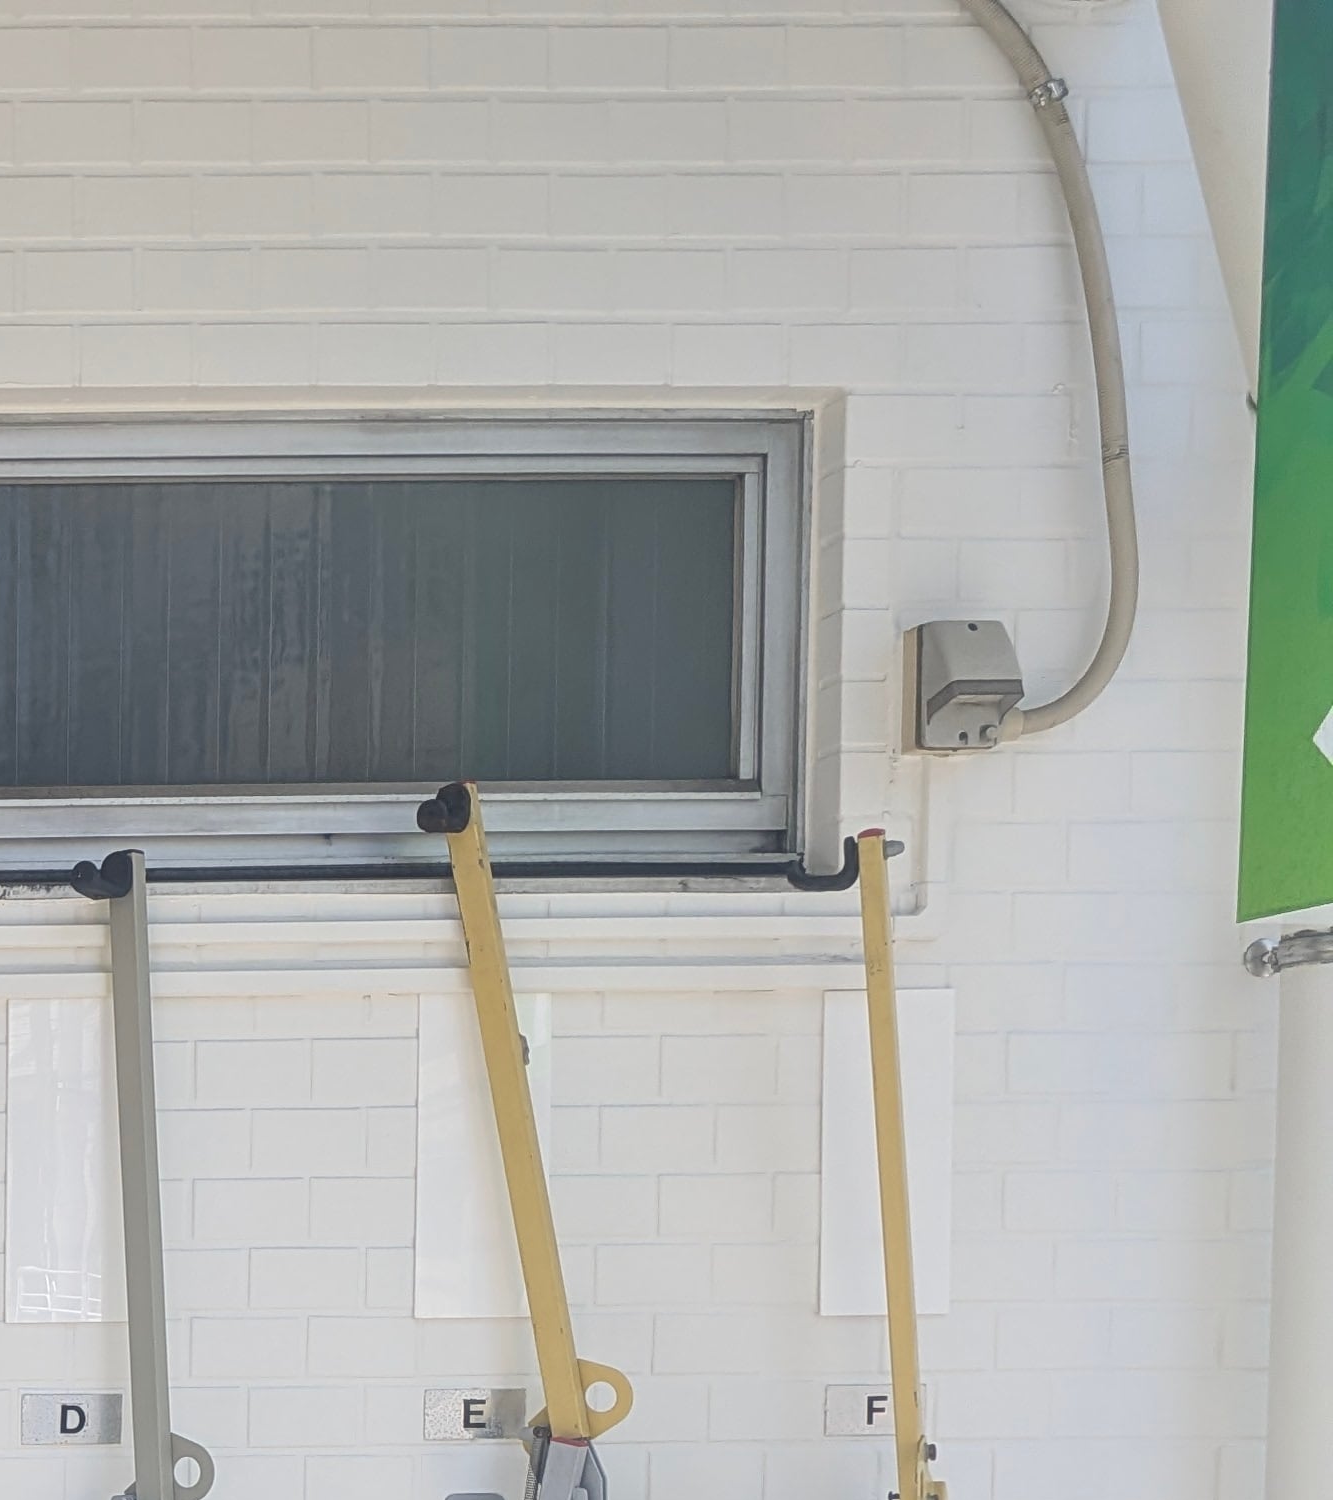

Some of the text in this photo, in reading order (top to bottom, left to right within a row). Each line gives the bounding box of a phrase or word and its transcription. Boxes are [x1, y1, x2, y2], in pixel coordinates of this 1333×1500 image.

[60, 1404, 86, 1434] D
[463, 1399, 487, 1428] E
[866, 1395, 889, 1425] F
